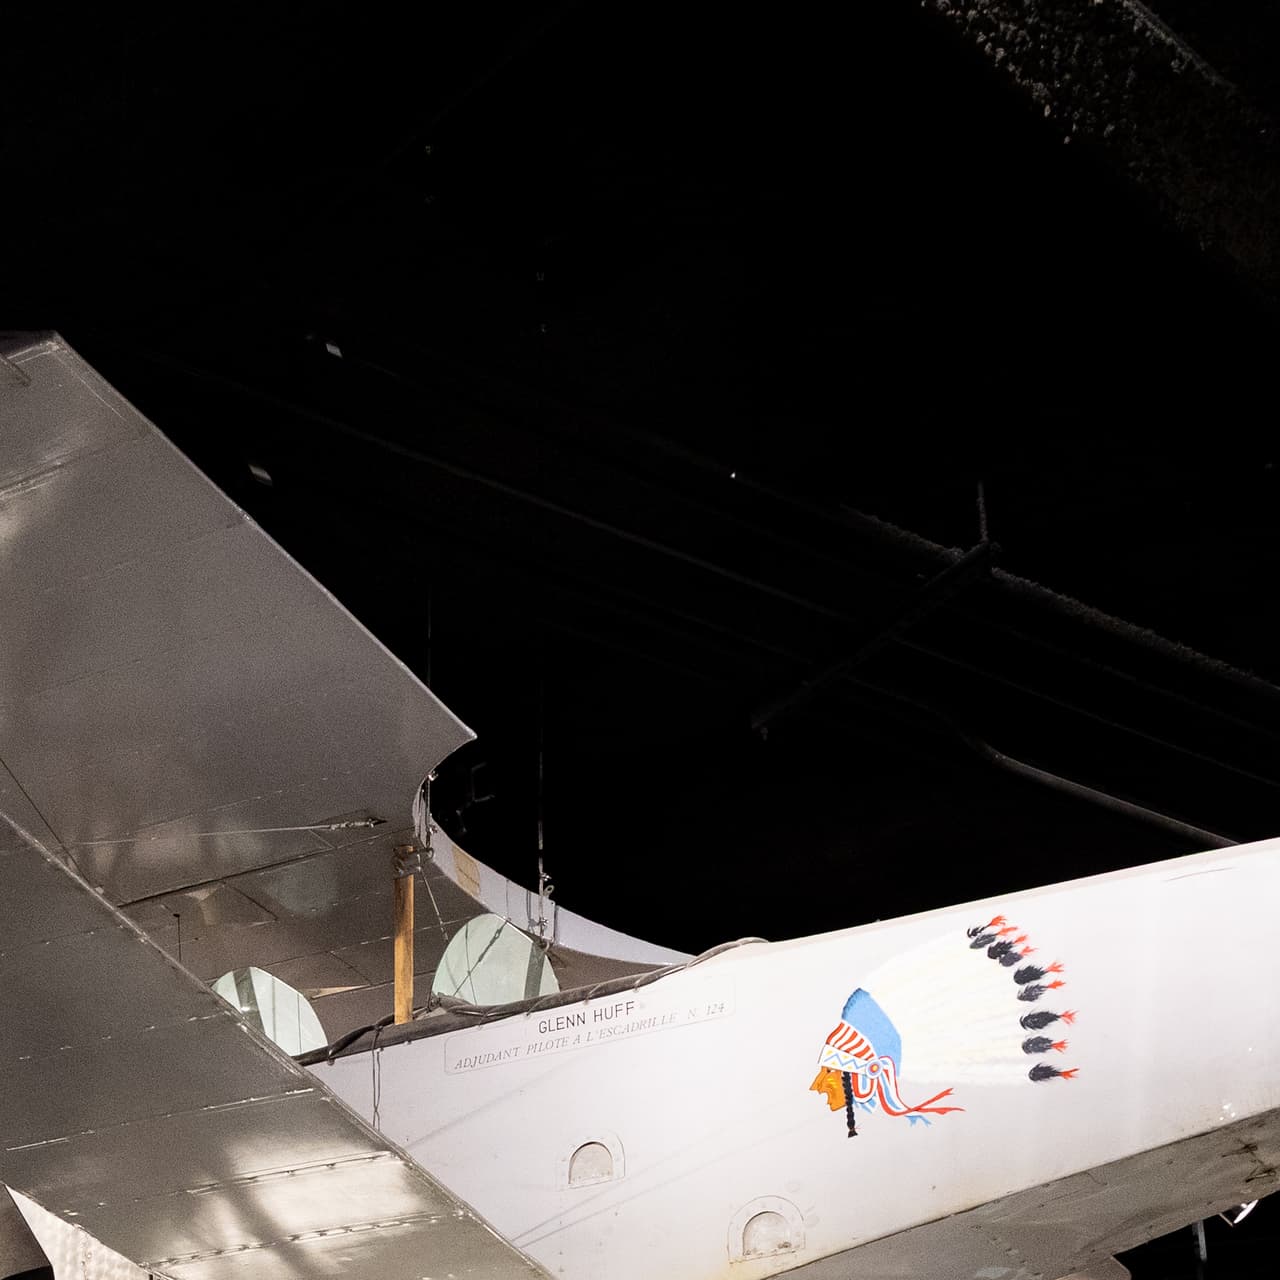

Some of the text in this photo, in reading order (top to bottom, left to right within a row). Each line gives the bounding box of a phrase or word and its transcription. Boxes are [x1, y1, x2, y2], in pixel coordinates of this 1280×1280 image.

[454, 1047, 521, 1070] ADJUDANT
[526, 1036, 569, 1056] PILOTE
[572, 1034, 583, 1046] A
[706, 1002, 725, 1016] 124
[538, 1001, 635, 1034] GLENN HUFF
